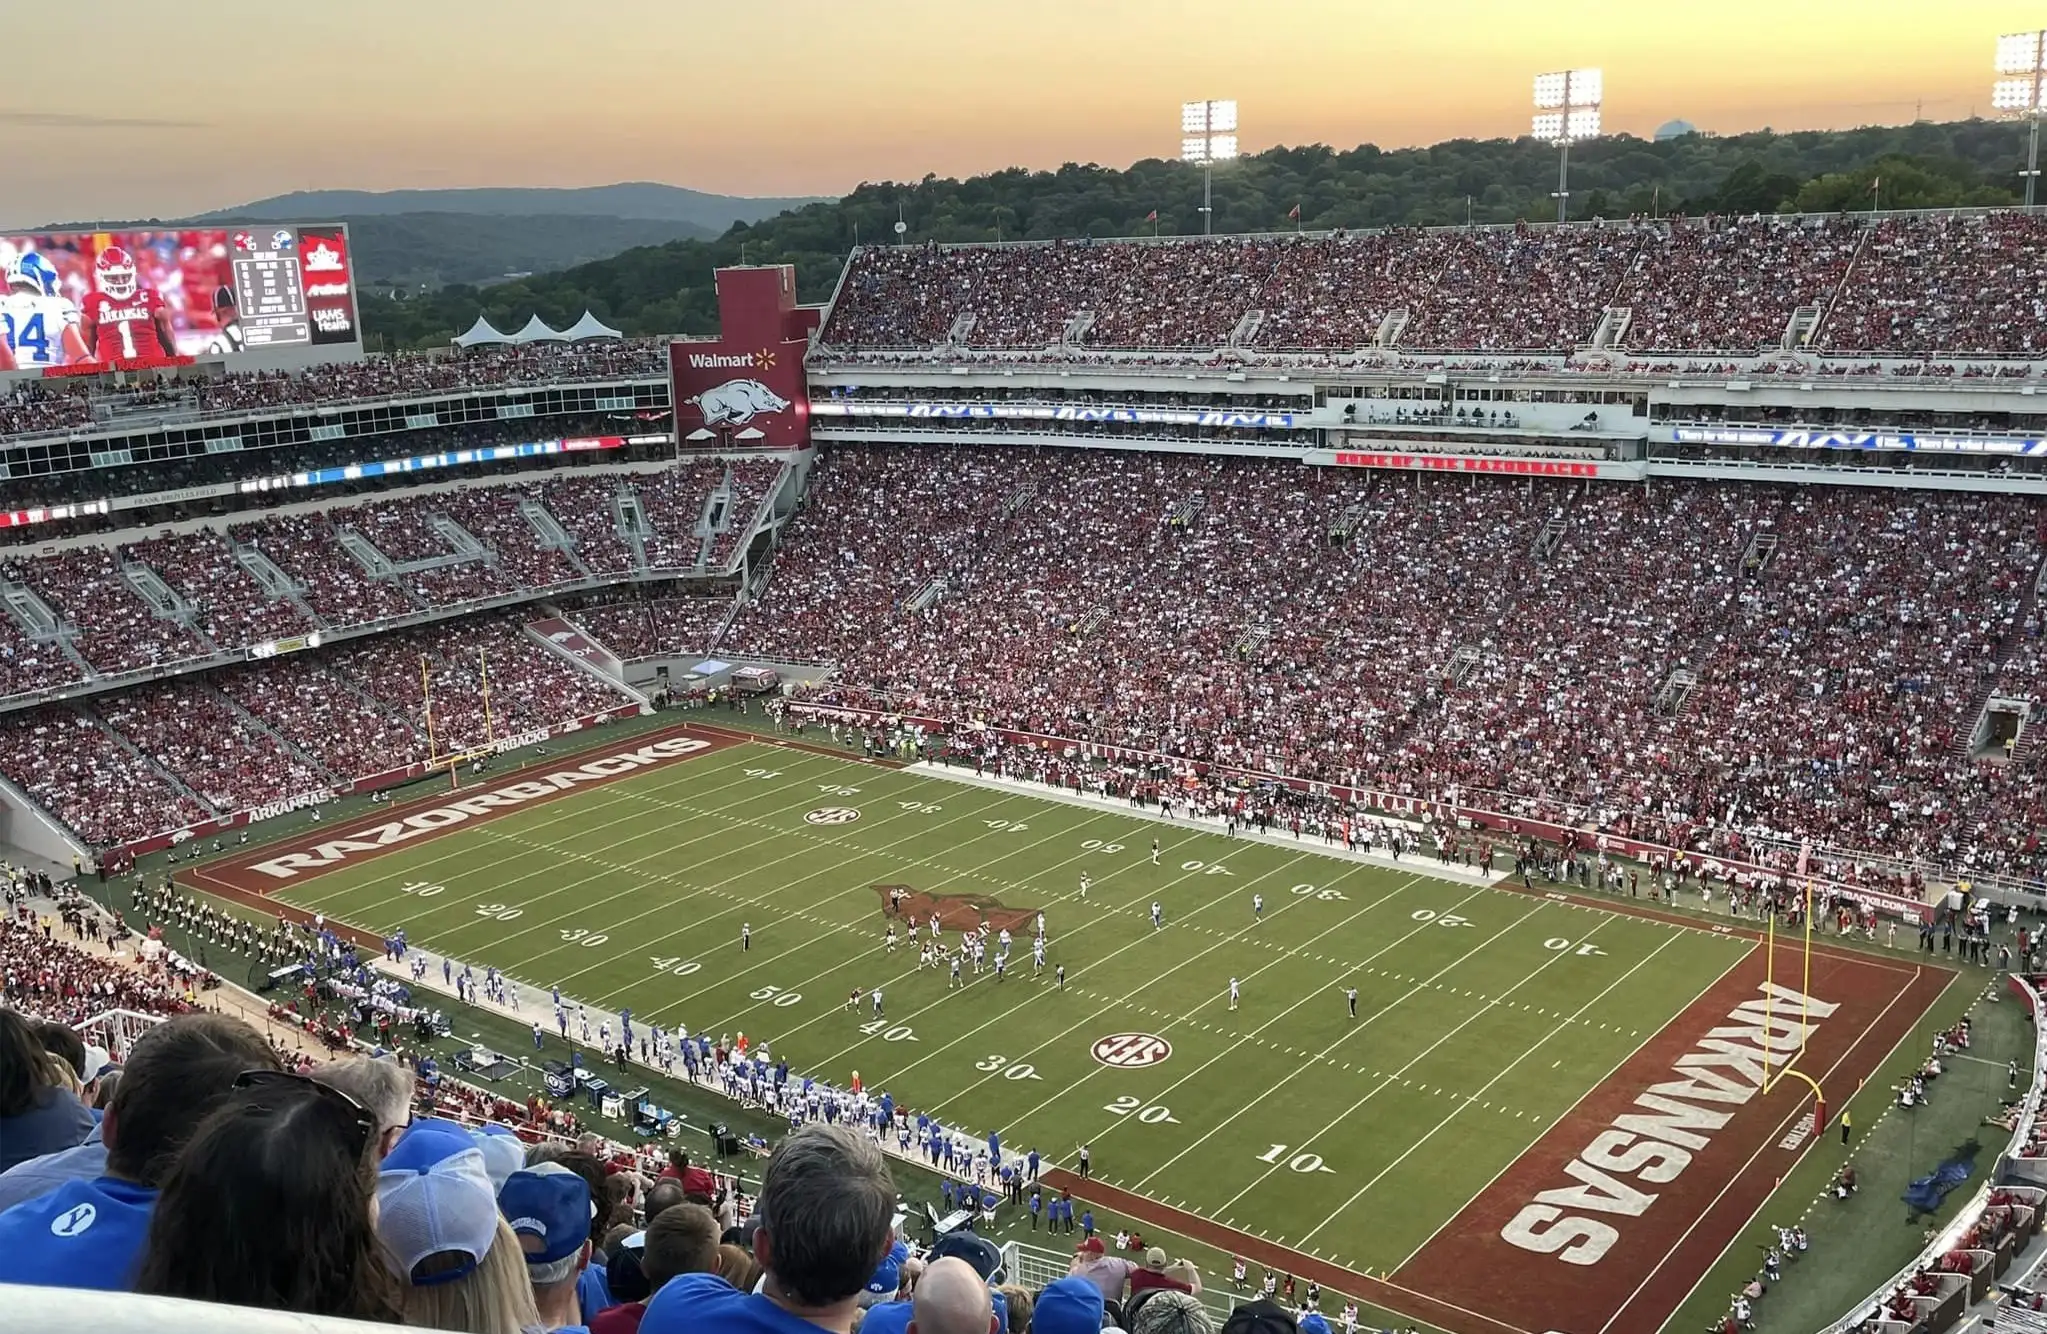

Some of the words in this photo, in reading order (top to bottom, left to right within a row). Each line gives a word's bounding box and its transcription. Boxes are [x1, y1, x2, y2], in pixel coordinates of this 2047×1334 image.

[312, 308, 344, 321] UAMS
[118, 321, 136, 359] 1
[689, 352, 754, 368] Walmart
[245, 737, 711, 879] RAZORBACKS
[248, 791, 329, 824] ARKANSAS
[1080, 839, 1125, 853] 50
[1180, 860, 1227, 875] 40
[408, 880, 445, 897] 10
[1290, 884, 1342, 900] 30
[480, 903, 524, 921] 20
[1411, 909, 1467, 927] 20
[567, 929, 609, 947] 30
[1543, 937, 1598, 956] 10
[655, 955, 702, 976] 40
[750, 985, 802, 1007] 50
[858, 1019, 914, 1042] 40
[975, 1054, 1039, 1081] 30
[1103, 1096, 1171, 1124] 20
[1501, 981, 1841, 1266] ARKANSAS
[1256, 1143, 1325, 1173] 10
